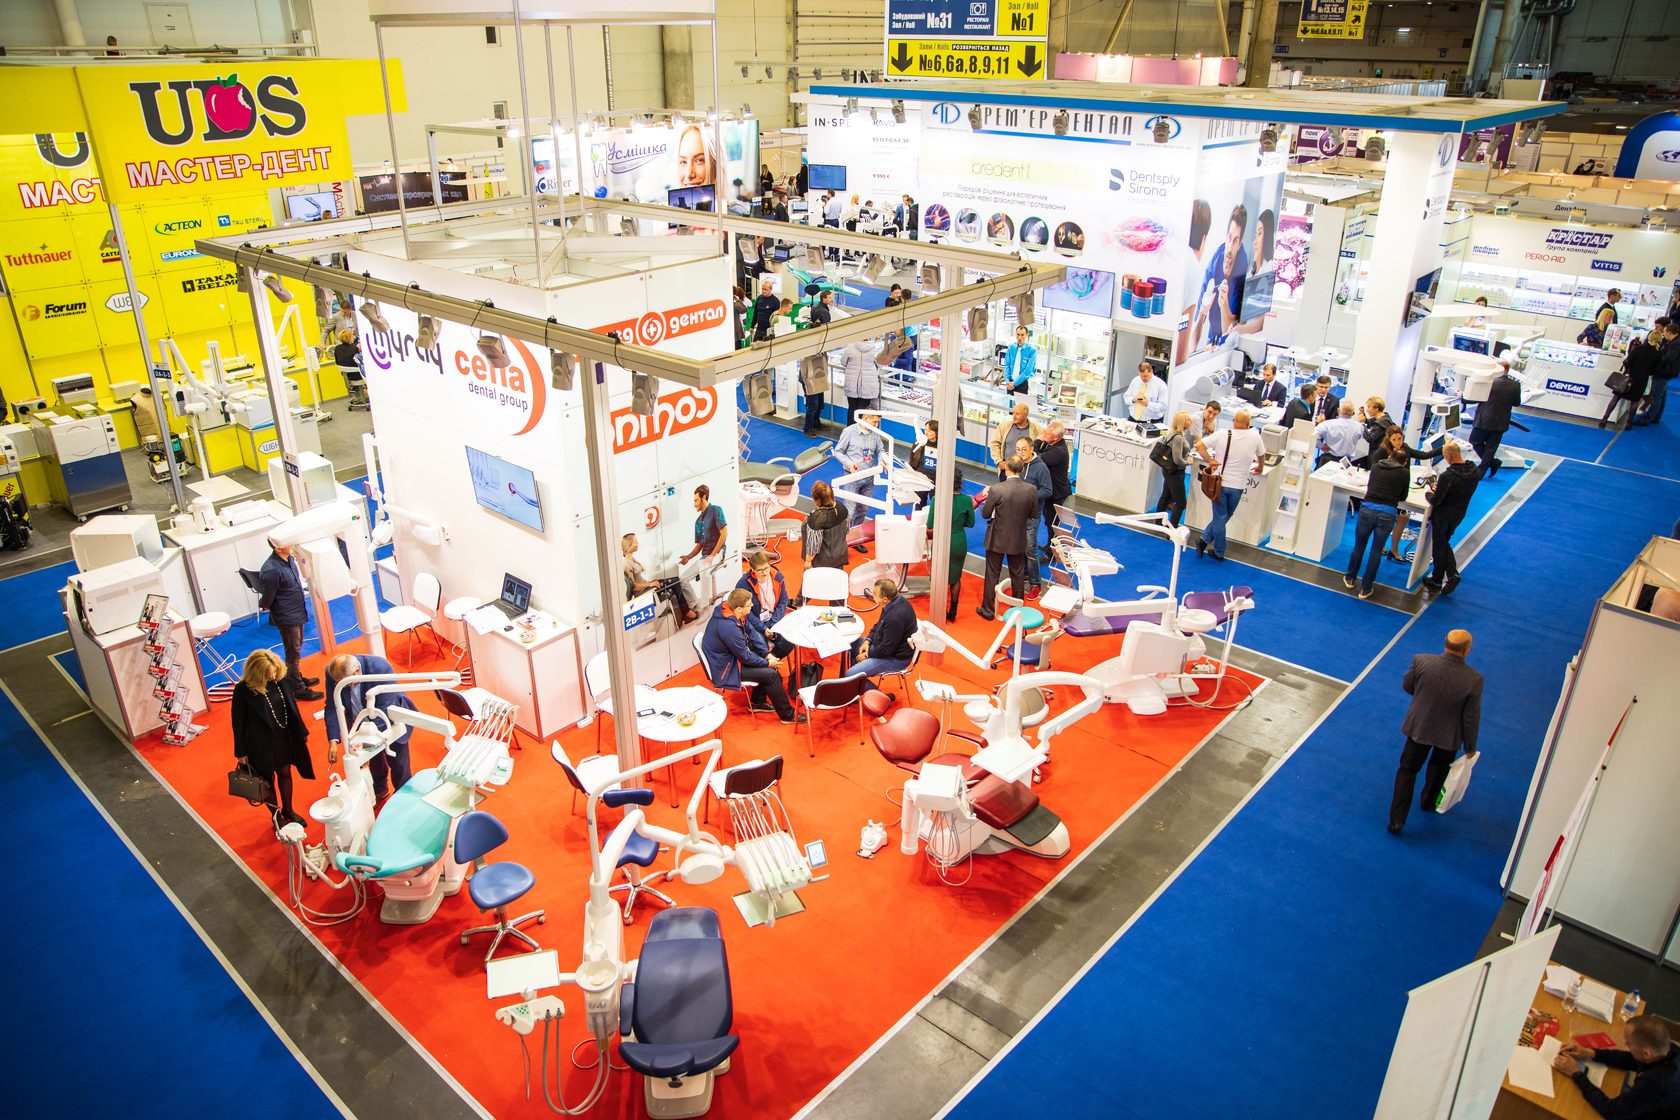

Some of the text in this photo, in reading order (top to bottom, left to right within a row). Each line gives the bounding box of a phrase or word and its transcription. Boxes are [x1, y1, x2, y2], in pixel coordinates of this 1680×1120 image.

[927, 12, 953, 29] №31
[1011, 13, 1034, 31] №1
[607, 141, 668, 161] Усмішка
[125, 146, 332, 189] МАСТЕР-ДЕНТ
[547, 178, 572, 191] Rier
[1129, 170, 1180, 188] Dentsply
[1128, 183, 1167, 197] Sirona
[163, 219, 202, 232] ACTEON
[5, 249, 73, 267] Tuttnauer
[1546, 243, 1599, 255] Група компаній
[1593, 261, 1620, 271] VITIS
[45, 301, 87, 315] Forum
[669, 305, 724, 334] дентал
[1549, 381, 1586, 393] DENTAID
[468, 380, 529, 413] dental group
[1082, 440, 1139, 469] bredent
[626, 607, 654, 628] 2B-1-1
